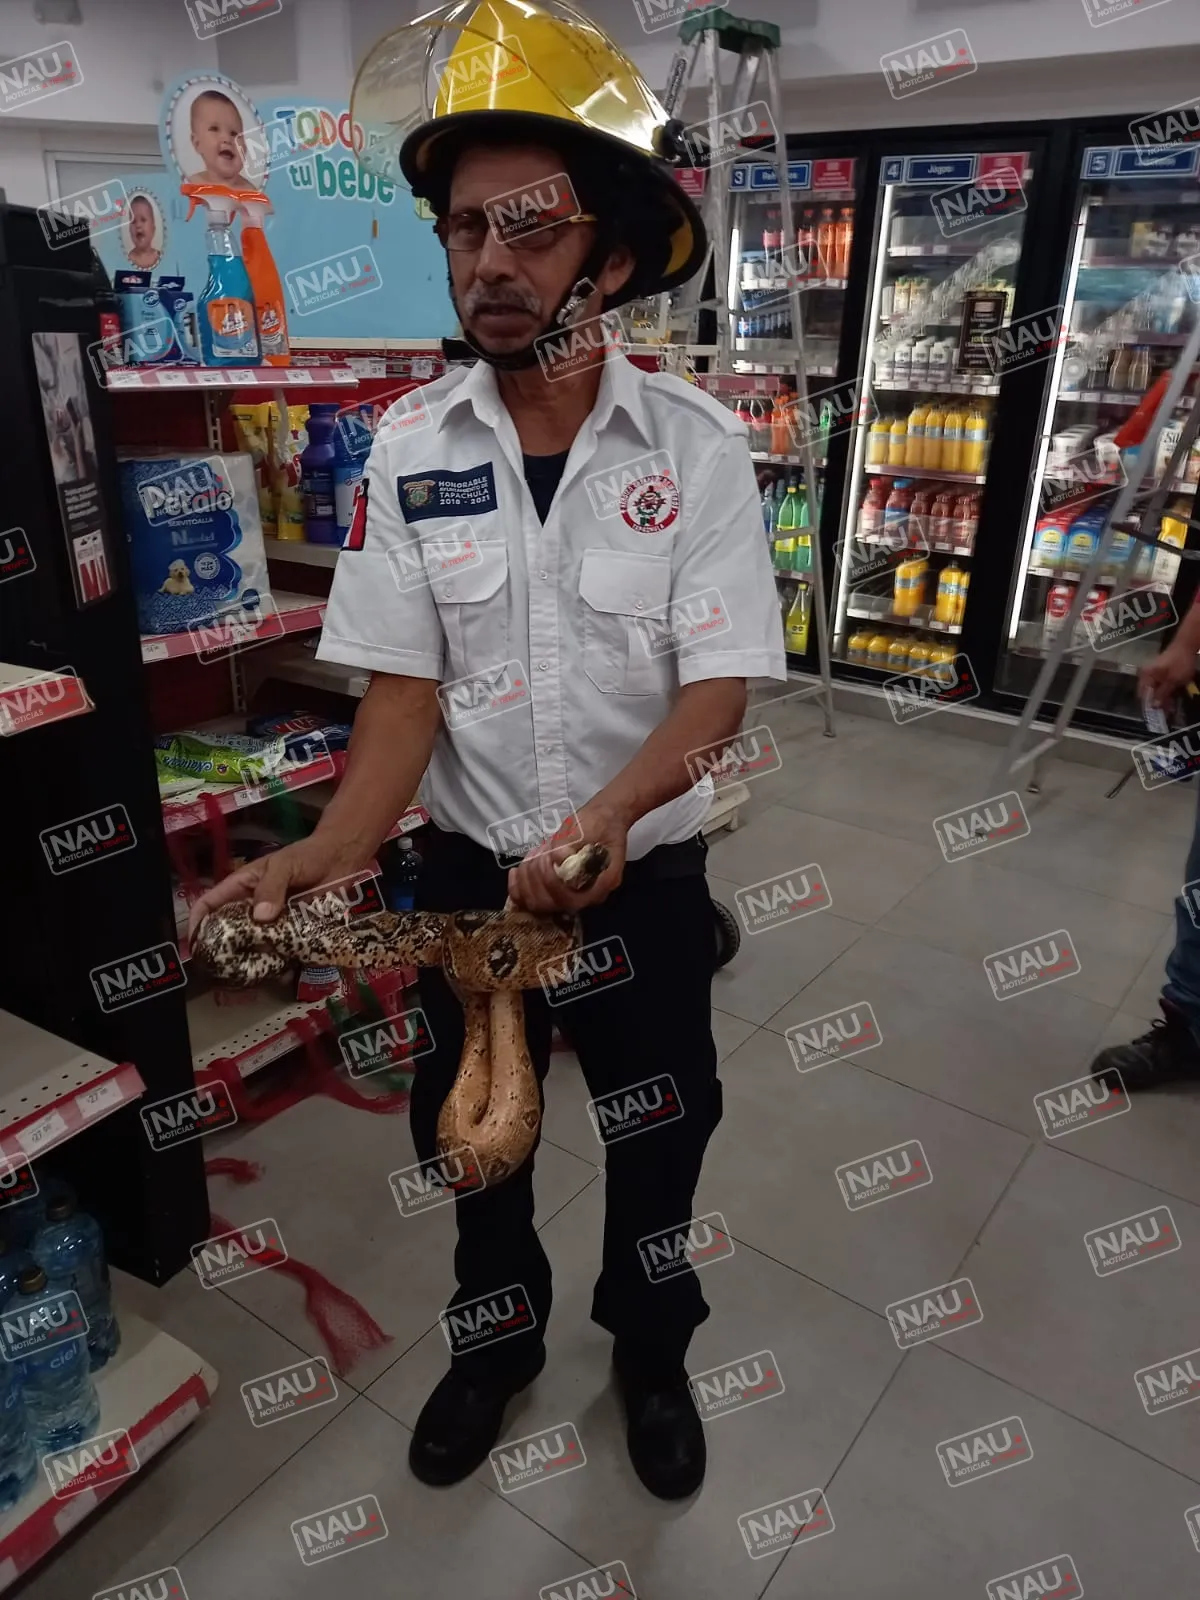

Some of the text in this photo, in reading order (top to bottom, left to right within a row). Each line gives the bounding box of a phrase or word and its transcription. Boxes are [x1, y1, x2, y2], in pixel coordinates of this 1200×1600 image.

[276, 110, 363, 150] TODO
[1092, 155, 1107, 171] 5
[290, 163, 312, 187] tu
[734, 171, 744, 184] 3
[887, 164, 899, 178] 4
[438, 476, 488, 488] HONORABLE
[439, 489, 489, 499] TAPACHULA
[470, 495, 490, 505] 2021
